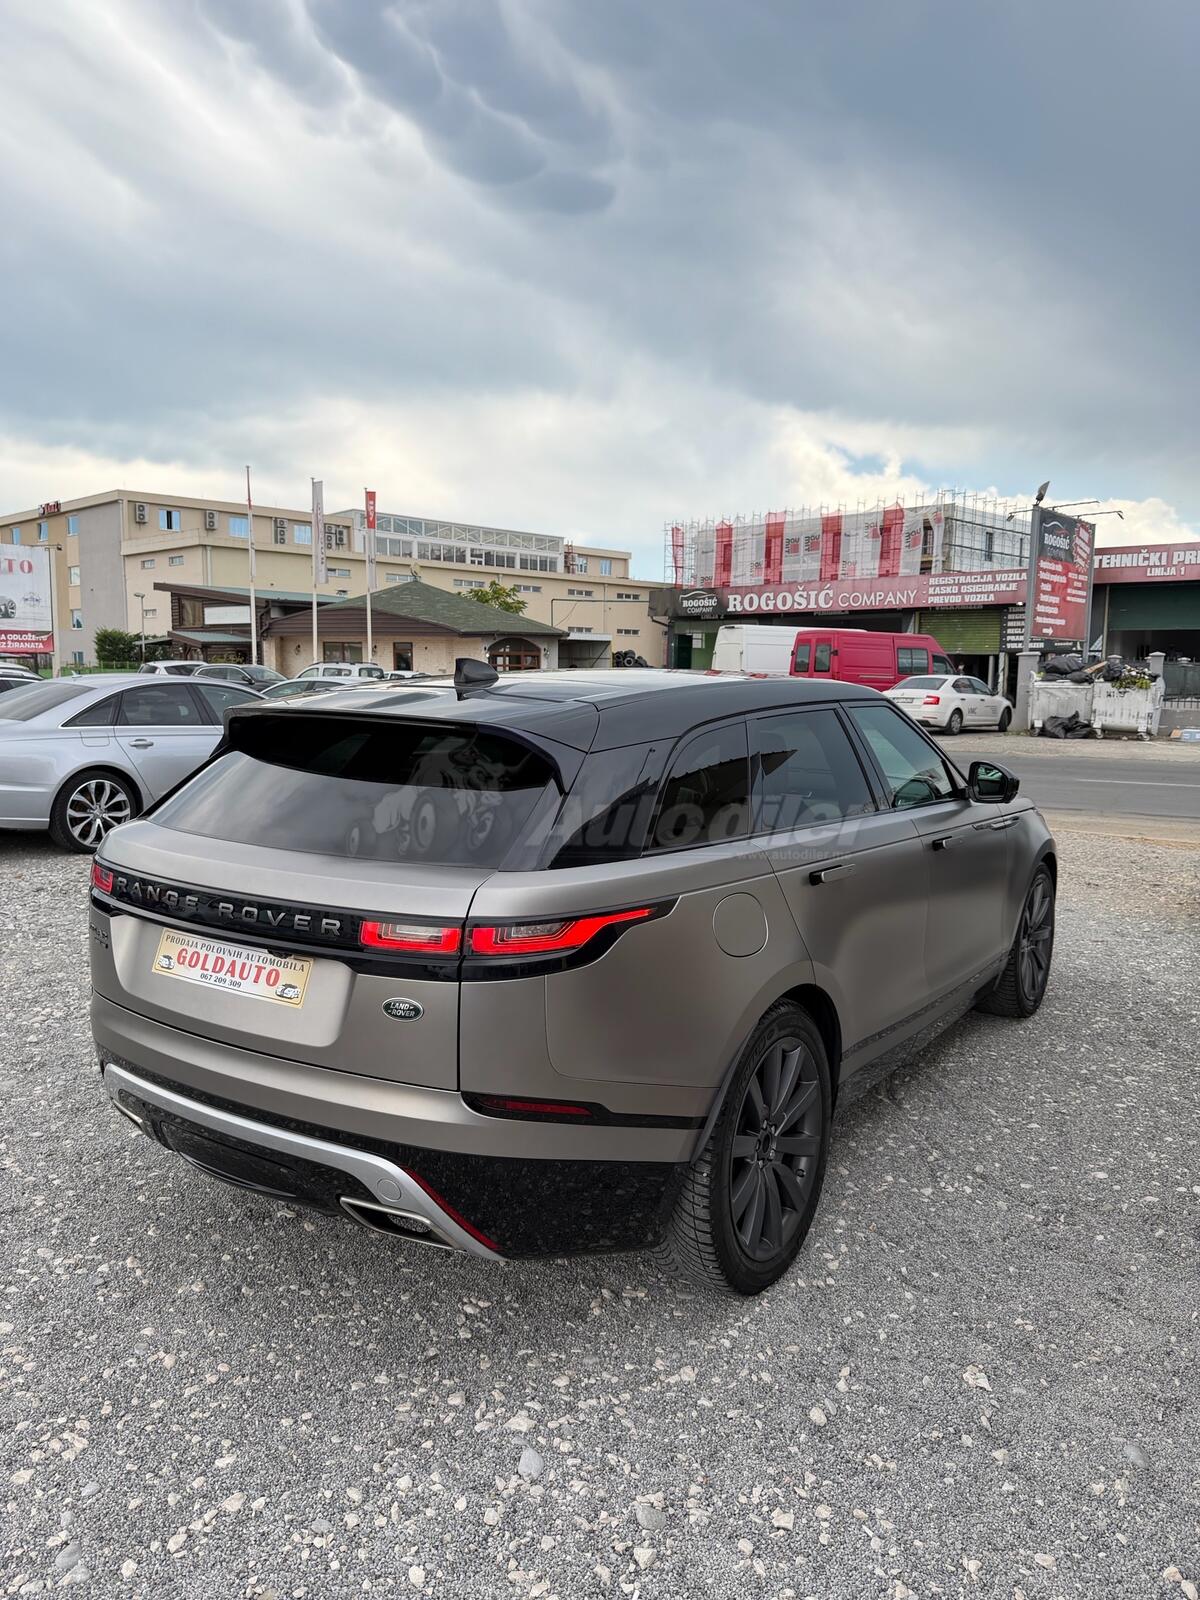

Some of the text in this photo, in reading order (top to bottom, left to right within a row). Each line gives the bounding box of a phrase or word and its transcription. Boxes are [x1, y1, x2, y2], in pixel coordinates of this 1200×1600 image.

[1093, 549, 1167, 568] TEHNIČKI
[0, 557, 33, 576] TO
[1146, 567, 1185, 576] LINIJA 1
[929, 572, 1027, 586] REGISTRACIJA VOZILA
[928, 583, 1018, 595] KASKO OSIGURANJE
[682, 597, 718, 608] ROGOŠIĆ
[727, 583, 917, 612] ROGOŠIĆ COMPANY
[927, 593, 995, 605] PREVOD VOZILA
[687, 606, 713, 614] COMPANY
[7, 641, 44, 649] ŽIRANATA
[117, 875, 343, 936] RANGE ROVER
[165, 934, 305, 973] PRODAJA POLOVNIH AUTOMOBILA
[176, 948, 281, 987] GOLDAUTO
[200, 973, 242, 988] 067 209 309
[390, 1002, 410, 1010] LAND
[391, 1009, 415, 1017] ROVER
